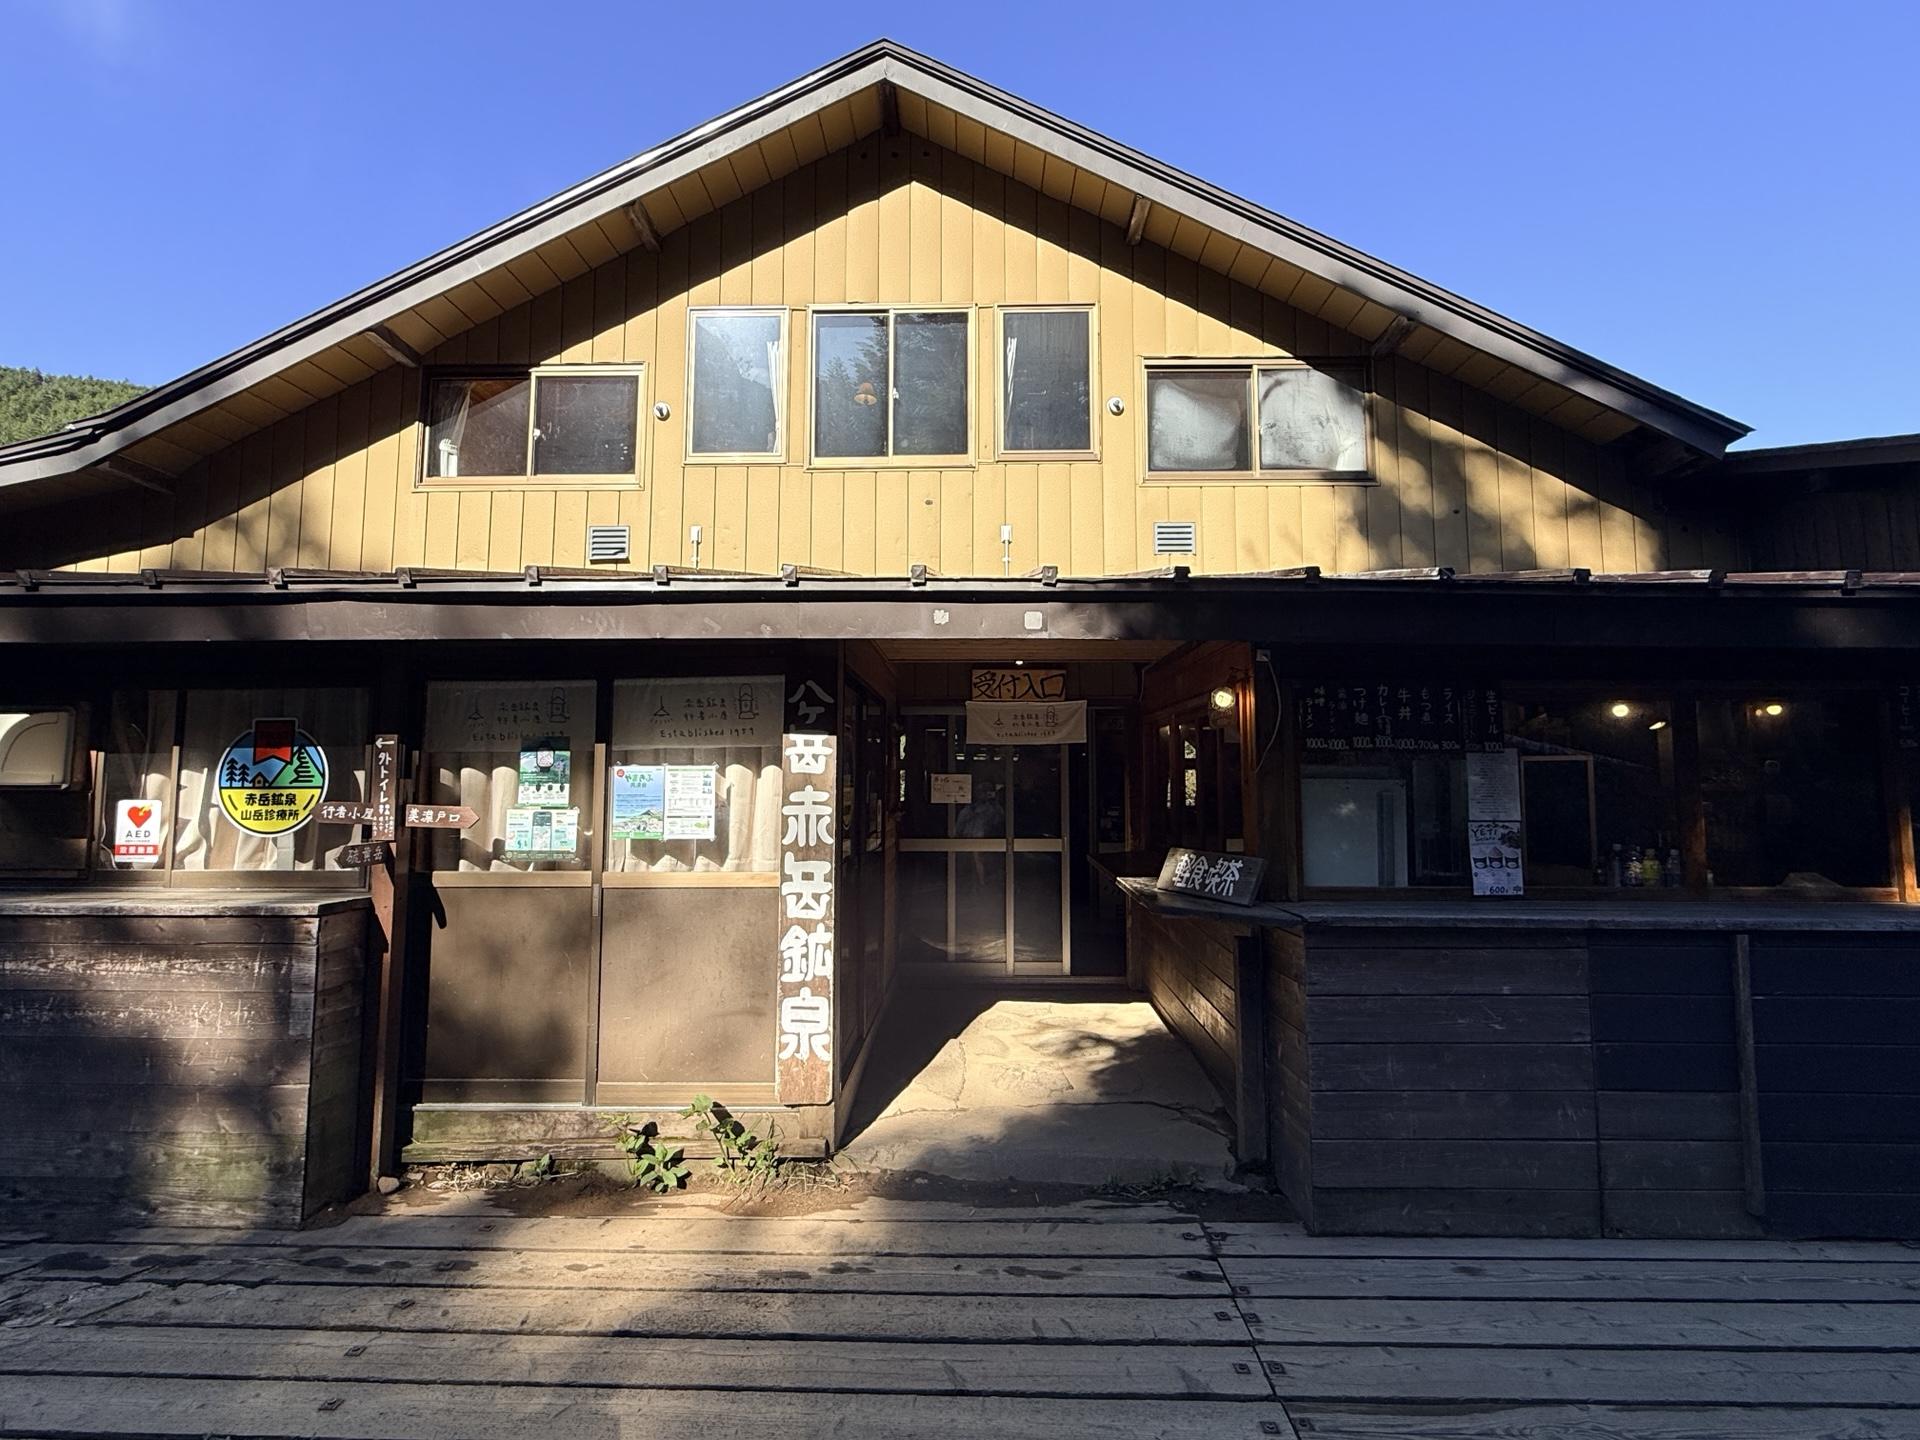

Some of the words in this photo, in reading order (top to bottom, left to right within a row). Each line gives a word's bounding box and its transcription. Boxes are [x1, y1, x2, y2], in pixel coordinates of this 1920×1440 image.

[974, 671, 1065, 699] 受付入口
[1443, 688, 1456, 725] ライス
[1486, 689, 1499, 734] 生ビール
[660, 728, 725, 738] Established
[378, 752, 392, 803] 外トイレ
[245, 793, 297, 806] 赤岳鉱泉
[241, 809, 299, 820] 山岳診療所
[408, 807, 461, 823] 美濃戸口
[126, 830, 151, 838] AED
[1471, 829, 1497, 839] YETI
